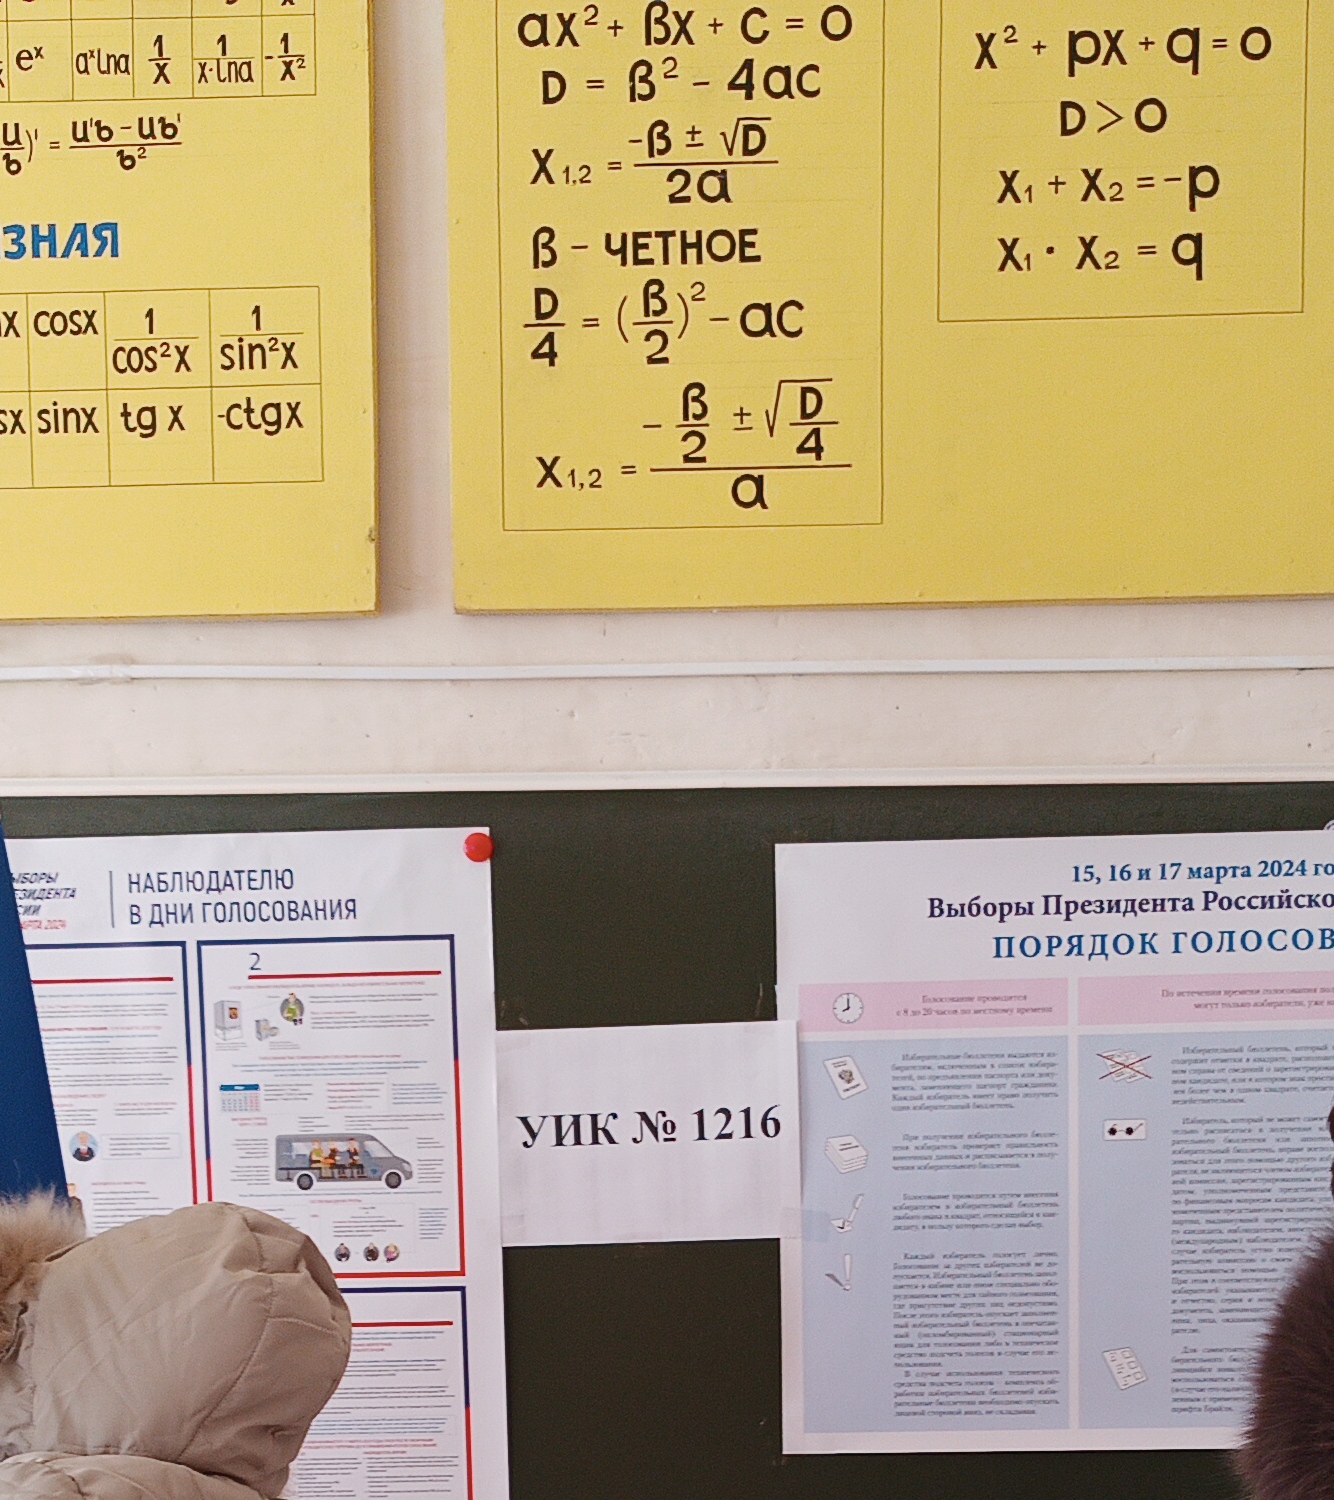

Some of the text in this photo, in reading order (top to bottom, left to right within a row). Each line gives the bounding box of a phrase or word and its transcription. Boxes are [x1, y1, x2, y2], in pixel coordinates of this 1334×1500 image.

[604, 227, 762, 268] ЧЕТНОЕ
[128, 868, 294, 895] НАБЛЮДАТЕЛЮ
[1109, 864, 1132, 881] 16
[1136, 867, 1150, 881] и
[1158, 862, 1182, 881] 17
[1187, 864, 1252, 883] марта
[1257, 859, 1308, 878] 2024
[129, 898, 358, 928] В ДНИ ГОЛОСОВАНИЯ
[928, 894, 1035, 922] Выборы
[1042, 893, 1195, 921] Президента
[992, 931, 1161, 962] ПОРЯДОК
[249, 953, 262, 971] 2
[516, 1104, 781, 1149] УИК № 1216
